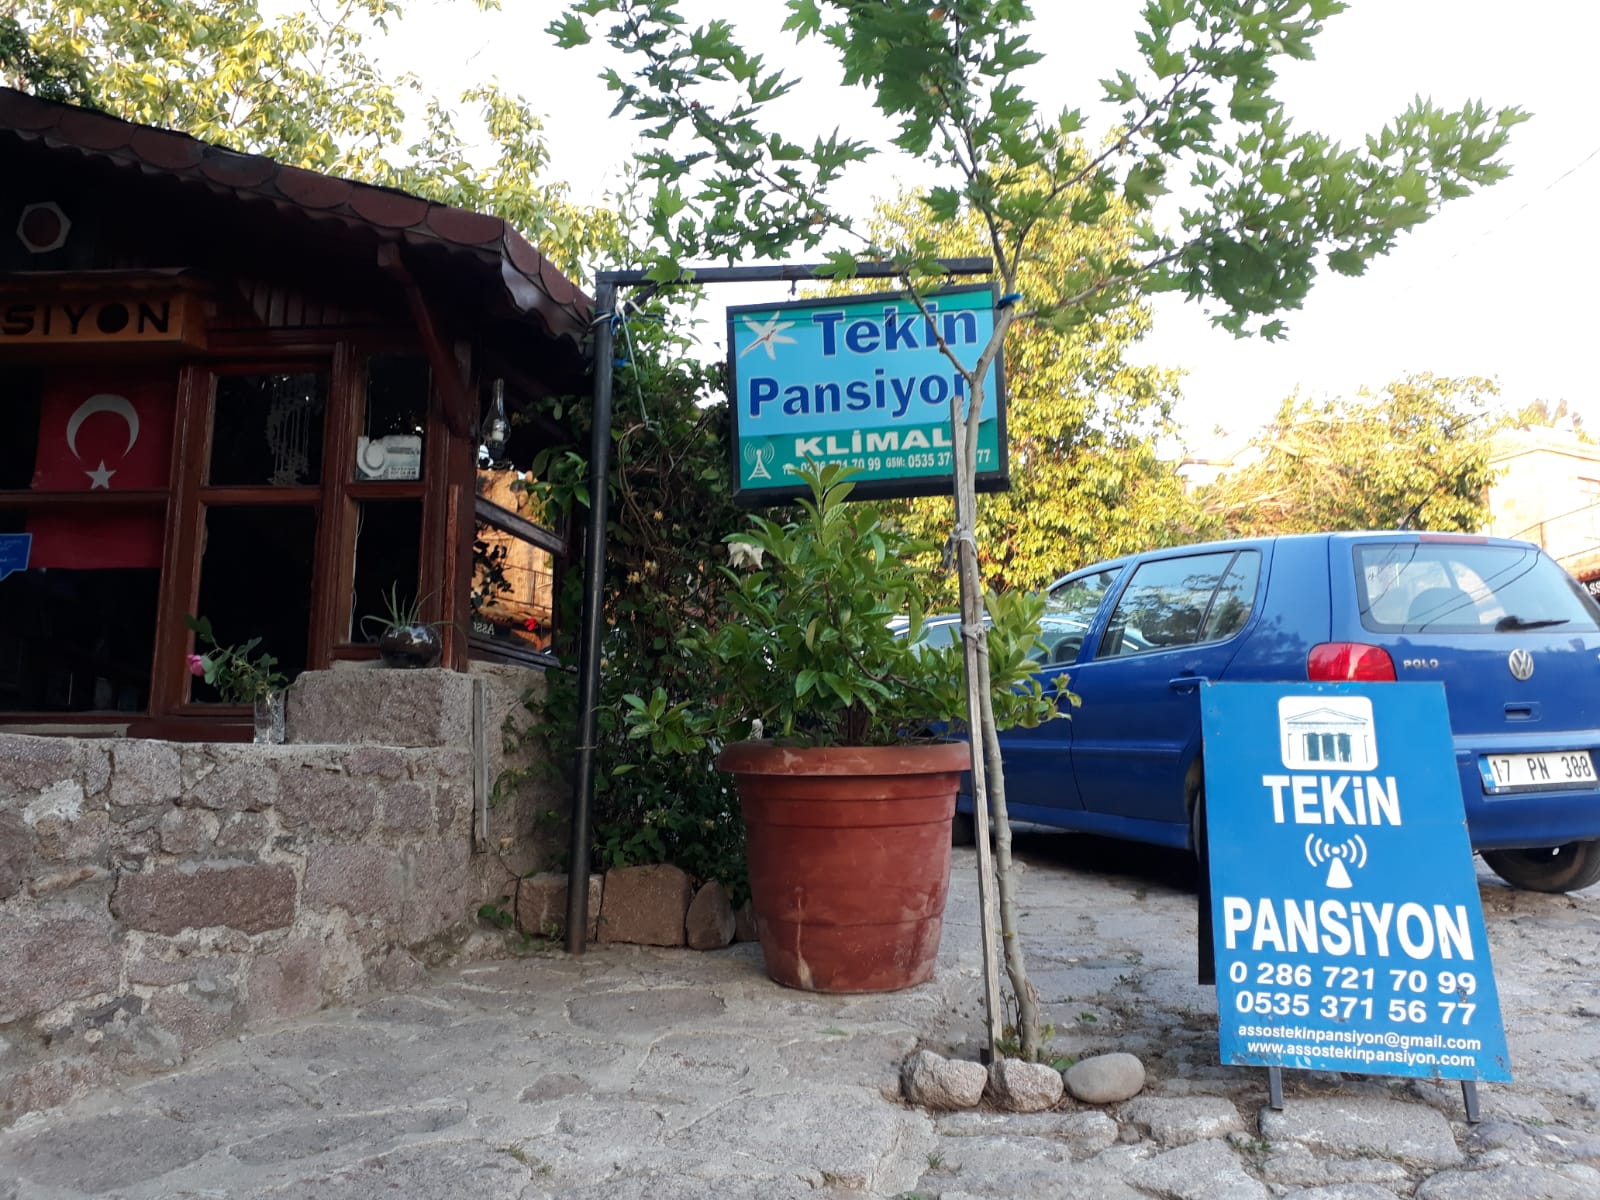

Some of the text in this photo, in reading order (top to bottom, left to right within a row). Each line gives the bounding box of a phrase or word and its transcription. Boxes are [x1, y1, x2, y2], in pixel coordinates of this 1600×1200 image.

[811, 302, 978, 356] Tekin
[868, 457, 880, 471] 99
[908, 453, 935, 468] 0535
[937, 451, 953, 466] 37
[977, 449, 991, 463] 77
[1403, 658, 1439, 669] POLO
[1493, 755, 1592, 783] 17 PN 388
[1229, 961, 1477, 995] 0 286 721 70 99
[1236, 990, 1477, 1025] 0535 371 56 77
[1238, 1025, 1481, 1051] assostekinpansiyon@gmail.com
[1247, 1041, 1476, 1067] www.assostekinpansiyon.com
